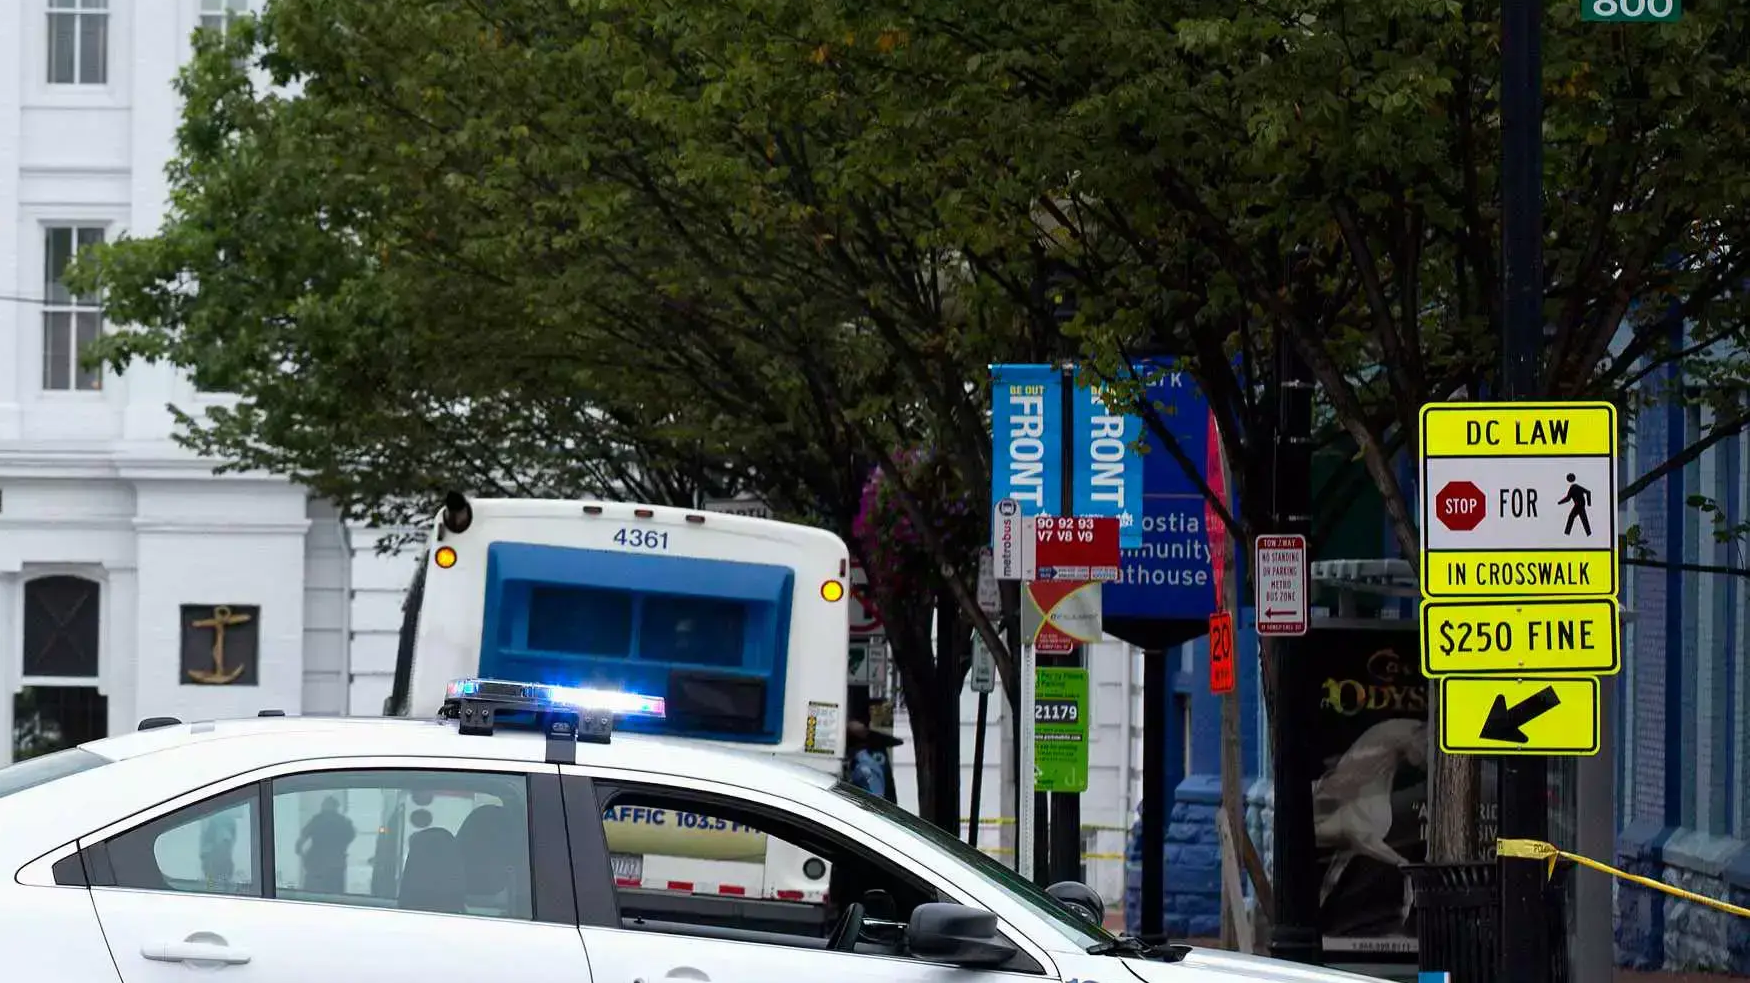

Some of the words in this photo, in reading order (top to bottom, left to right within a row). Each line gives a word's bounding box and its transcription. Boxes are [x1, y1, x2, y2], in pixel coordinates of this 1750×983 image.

[1010, 385, 1022, 395] BE
[1025, 385, 1044, 395] OUT
[1466, 420, 1500, 446] DC
[1515, 420, 1569, 446] LAW
[1010, 396, 1044, 508] FRONT
[1445, 497, 1478, 515] STOP
[1500, 489, 1538, 518] FOR
[1037, 518, 1054, 530] 90
[1058, 518, 1074, 530] 92
[1078, 518, 1094, 530] 93
[1037, 530, 1053, 542] V7
[1057, 530, 1073, 542] V8
[1078, 530, 1094, 542] V9
[614, 528, 668, 550] 4361
[1002, 519, 1012, 577] metrobus
[1448, 562, 1466, 586] IN
[1476, 562, 1591, 586] CROSSWALK
[1280, 592, 1296, 603] ZONE
[1212, 624, 1232, 662] 20
[1439, 619, 1513, 657] $250
[1528, 620, 1595, 651] FINE
[1035, 704, 1078, 720] 21179
